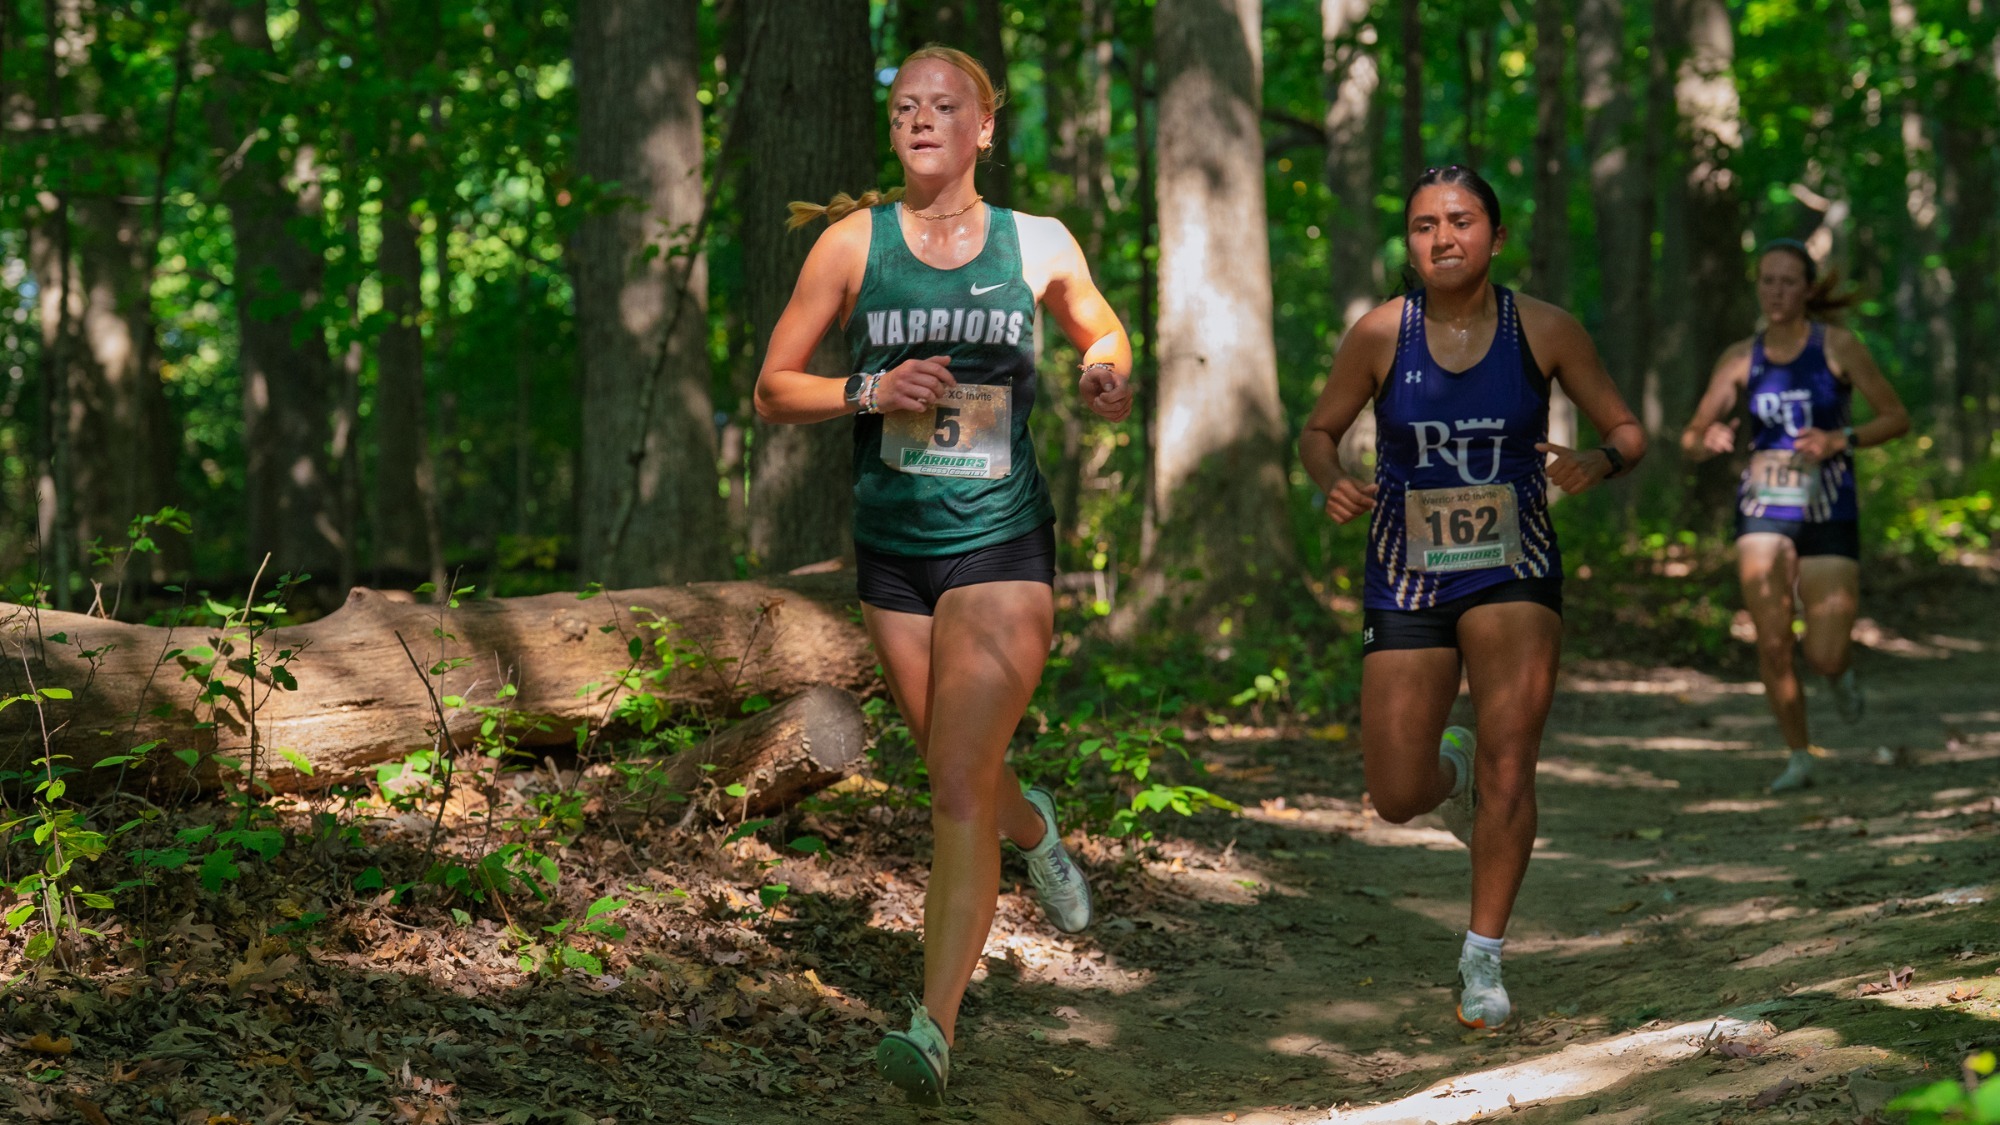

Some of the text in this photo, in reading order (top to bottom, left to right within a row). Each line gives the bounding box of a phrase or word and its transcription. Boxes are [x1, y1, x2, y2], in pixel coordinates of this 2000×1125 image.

[866, 307, 1024, 347] WARRIORS
[948, 390, 992, 402] XC Invite
[1756, 391, 1813, 438] RU
[933, 406, 960, 448] 5
[903, 448, 988, 469] WARRIORS
[1408, 420, 1508, 485] RU
[1457, 493, 1471, 502] XC
[1425, 506, 1500, 547] 162
[1426, 548, 1502, 568] WARRIORS
